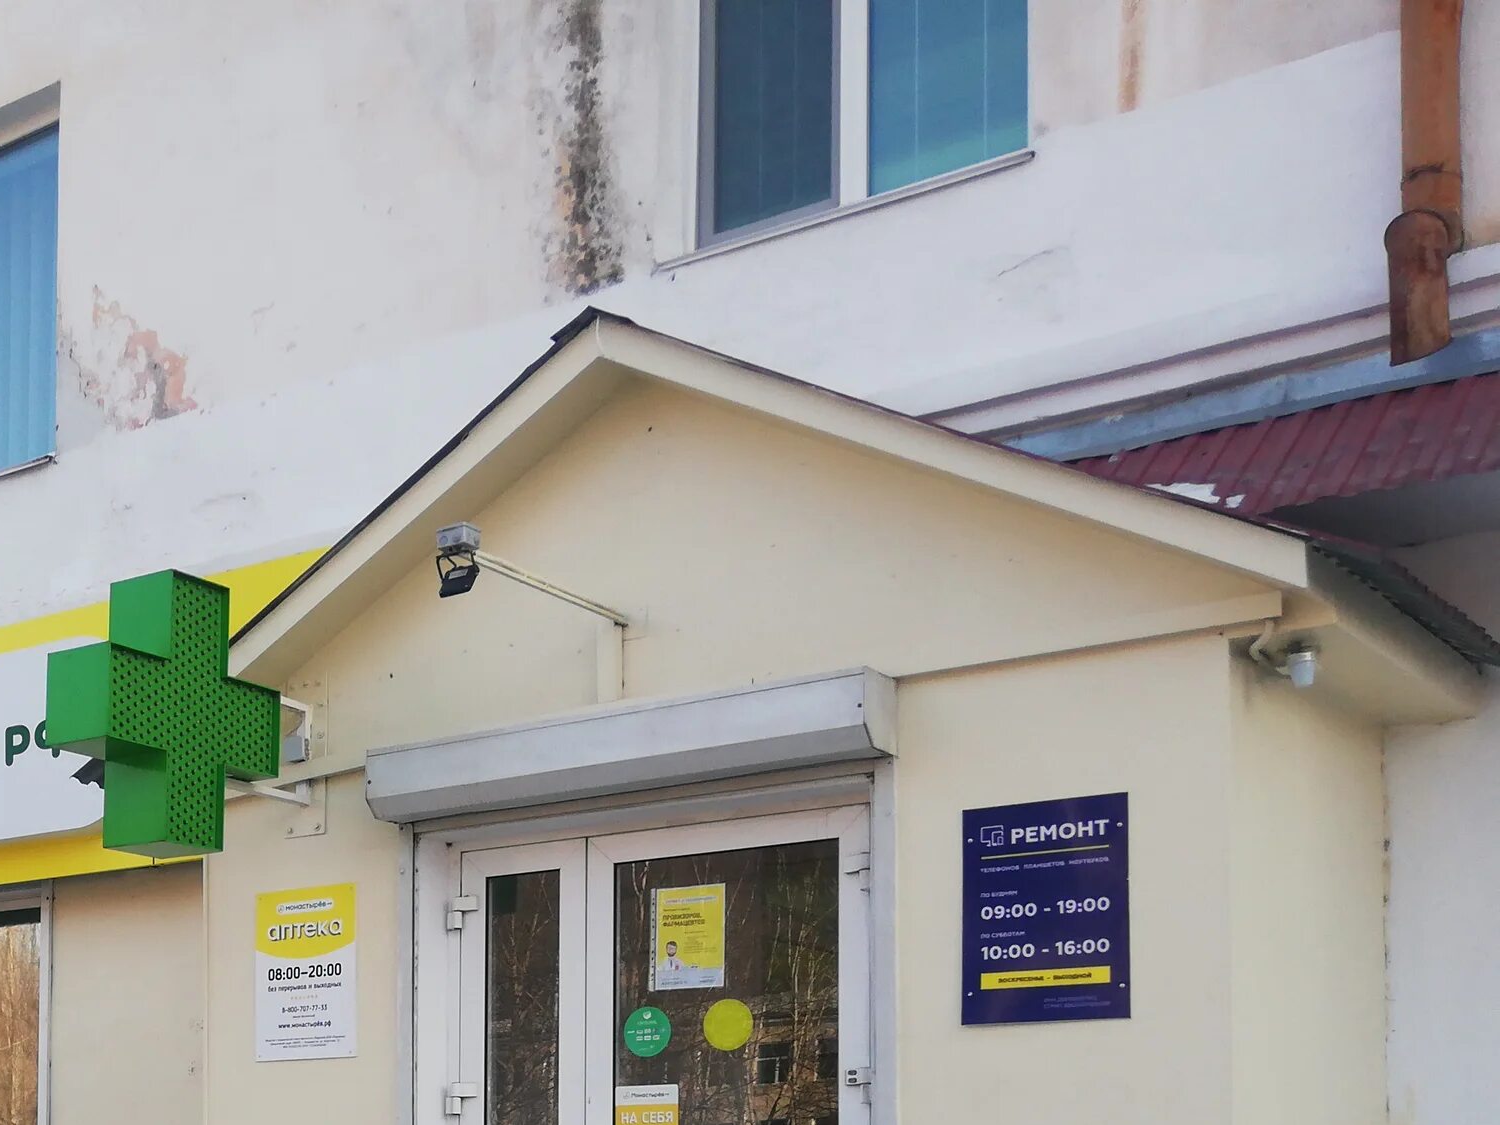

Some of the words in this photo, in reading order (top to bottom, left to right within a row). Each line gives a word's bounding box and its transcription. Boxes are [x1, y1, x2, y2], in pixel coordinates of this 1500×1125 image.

[1010, 818, 1110, 845] РЕМОНТ
[1023, 860, 1065, 870] ПЛАНШЕТОВ
[980, 902, 1038, 920] 09:00
[1056, 896, 1111, 914] 19:00
[267, 920, 342, 942] аптека
[980, 943, 1036, 961] 10:00
[1055, 938, 1110, 956] 16:00
[267, 962, 342, 981] 08:00-20:00
[620, 1111, 638, 1124] НА
[641, 1110, 674, 1123] СЕБЯ
